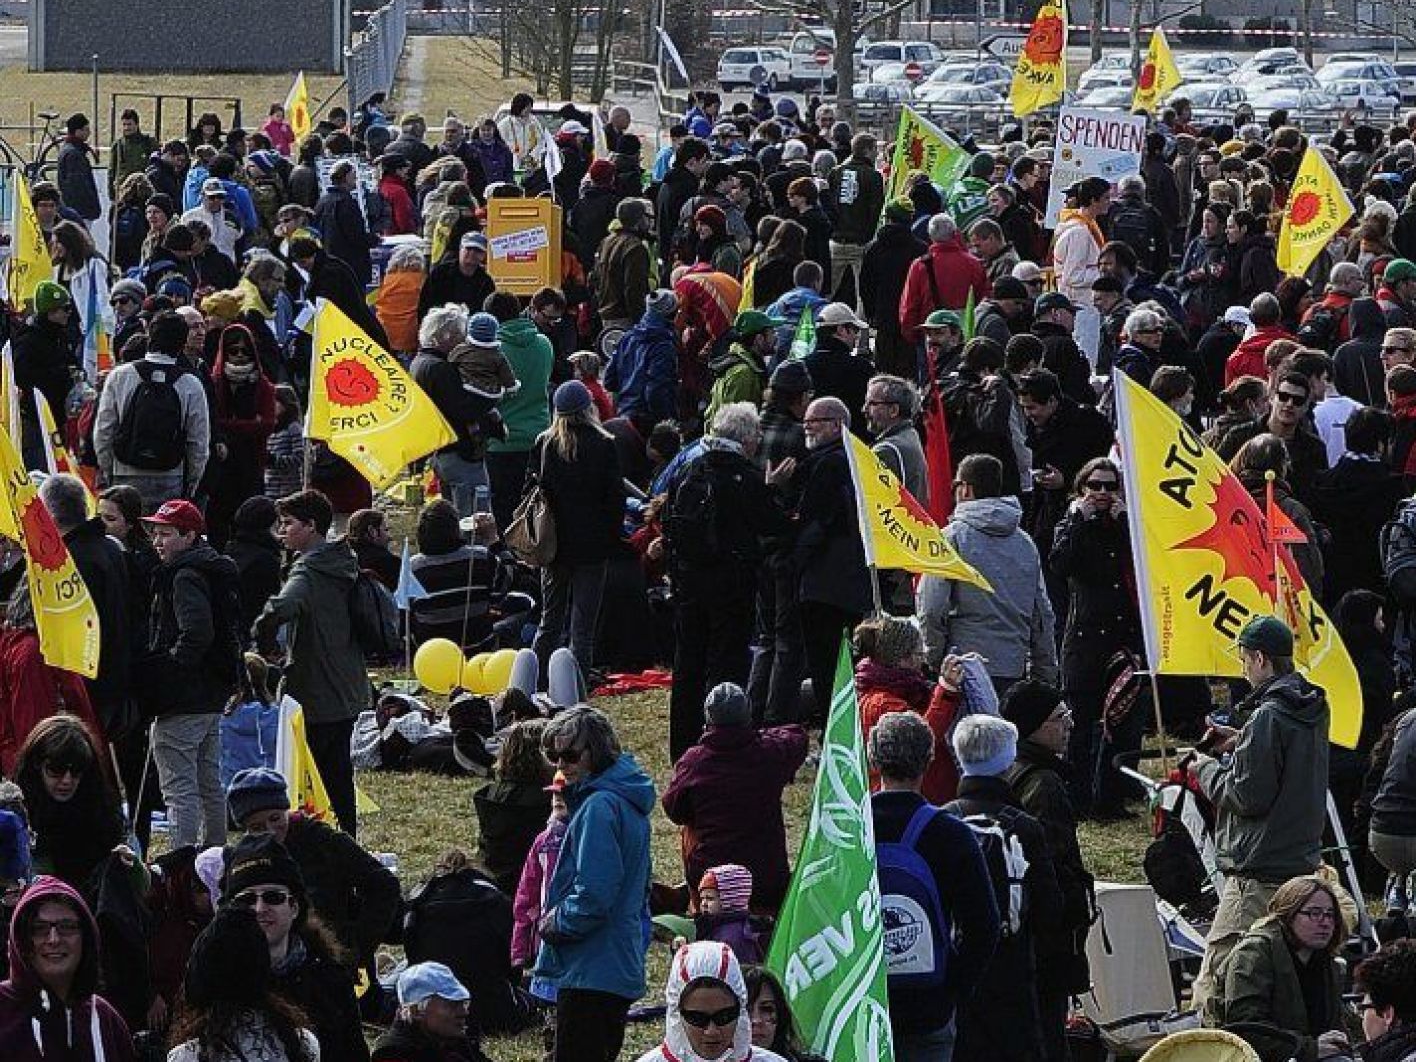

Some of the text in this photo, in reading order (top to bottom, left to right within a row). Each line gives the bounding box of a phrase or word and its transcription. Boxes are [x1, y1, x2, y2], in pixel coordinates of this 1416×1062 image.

[1002, 40, 1025, 54] Aus
[1061, 114, 1146, 154] SPENDEN
[329, 412, 379, 432] ERCI
